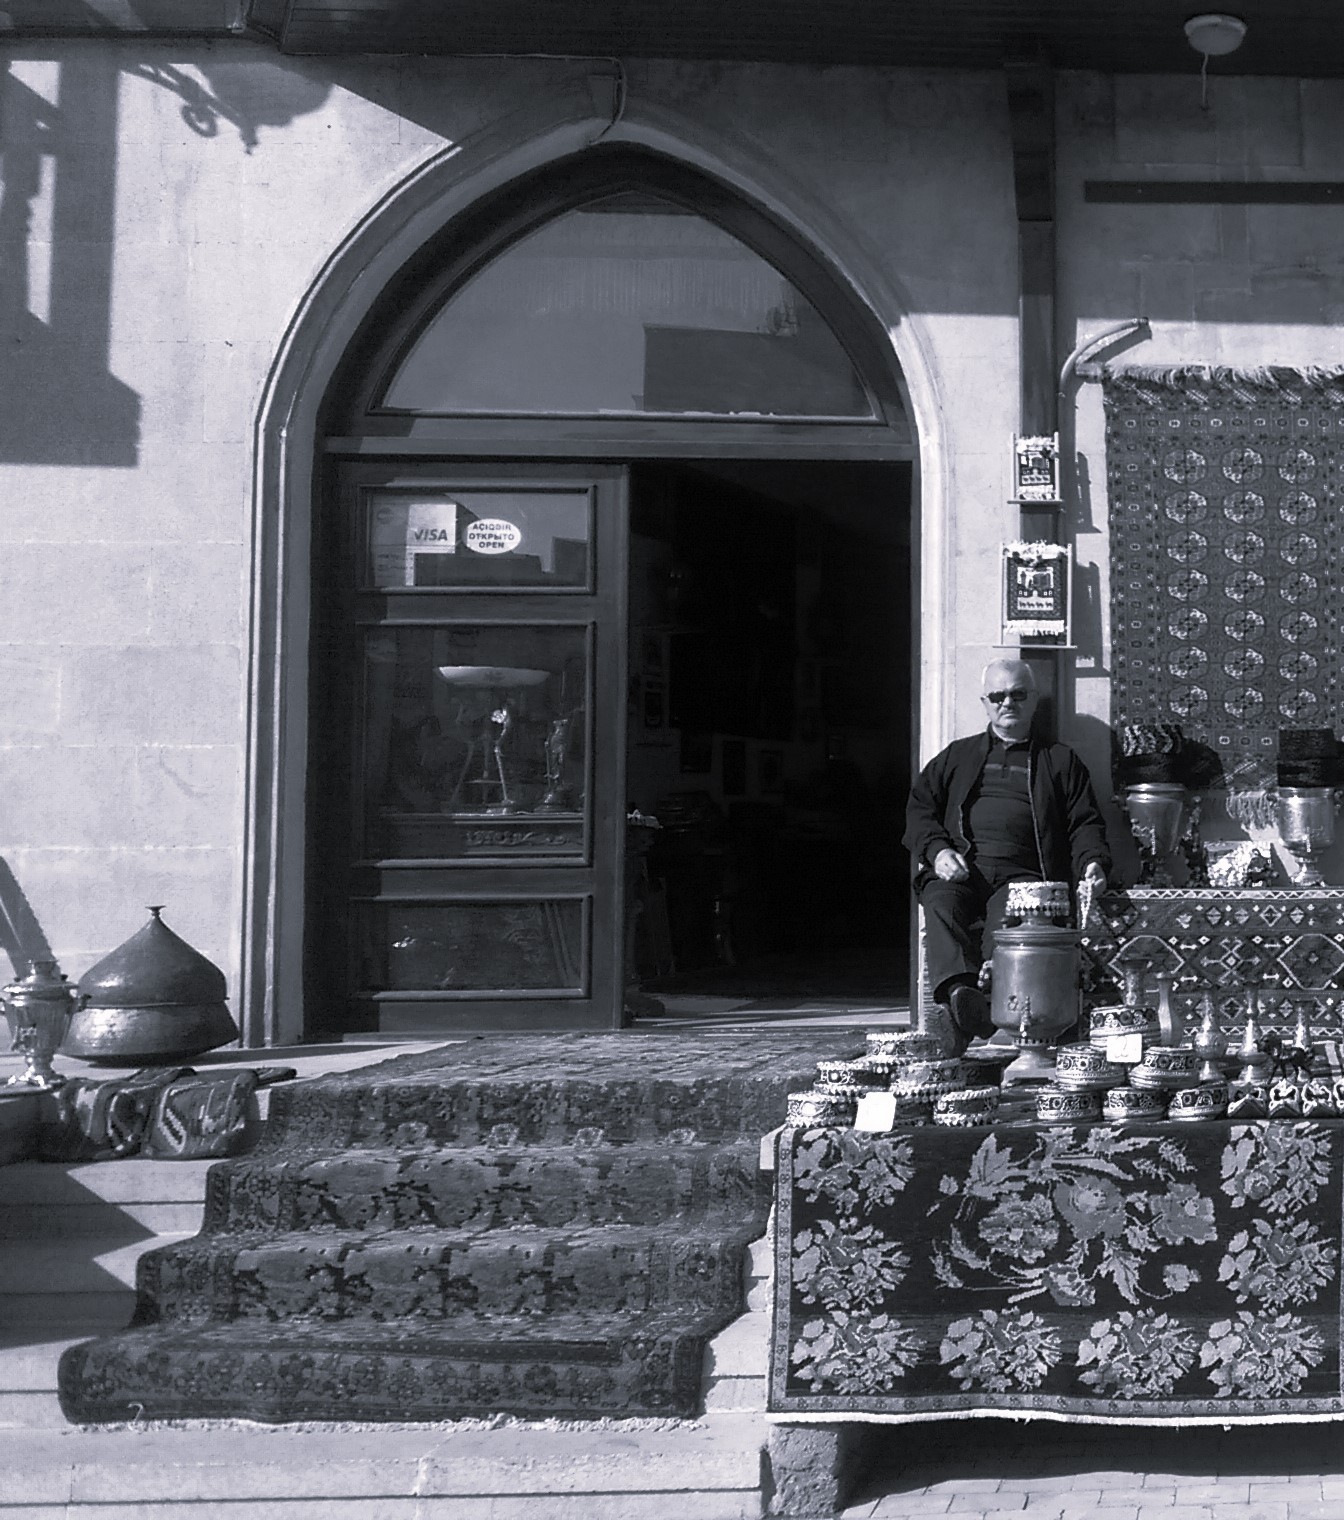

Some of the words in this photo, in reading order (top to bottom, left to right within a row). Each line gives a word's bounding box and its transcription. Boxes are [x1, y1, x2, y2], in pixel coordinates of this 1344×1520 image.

[414, 529, 448, 541] VISA
[468, 533, 515, 541] ОТКРЫТО
[479, 541, 505, 549] OPEN
